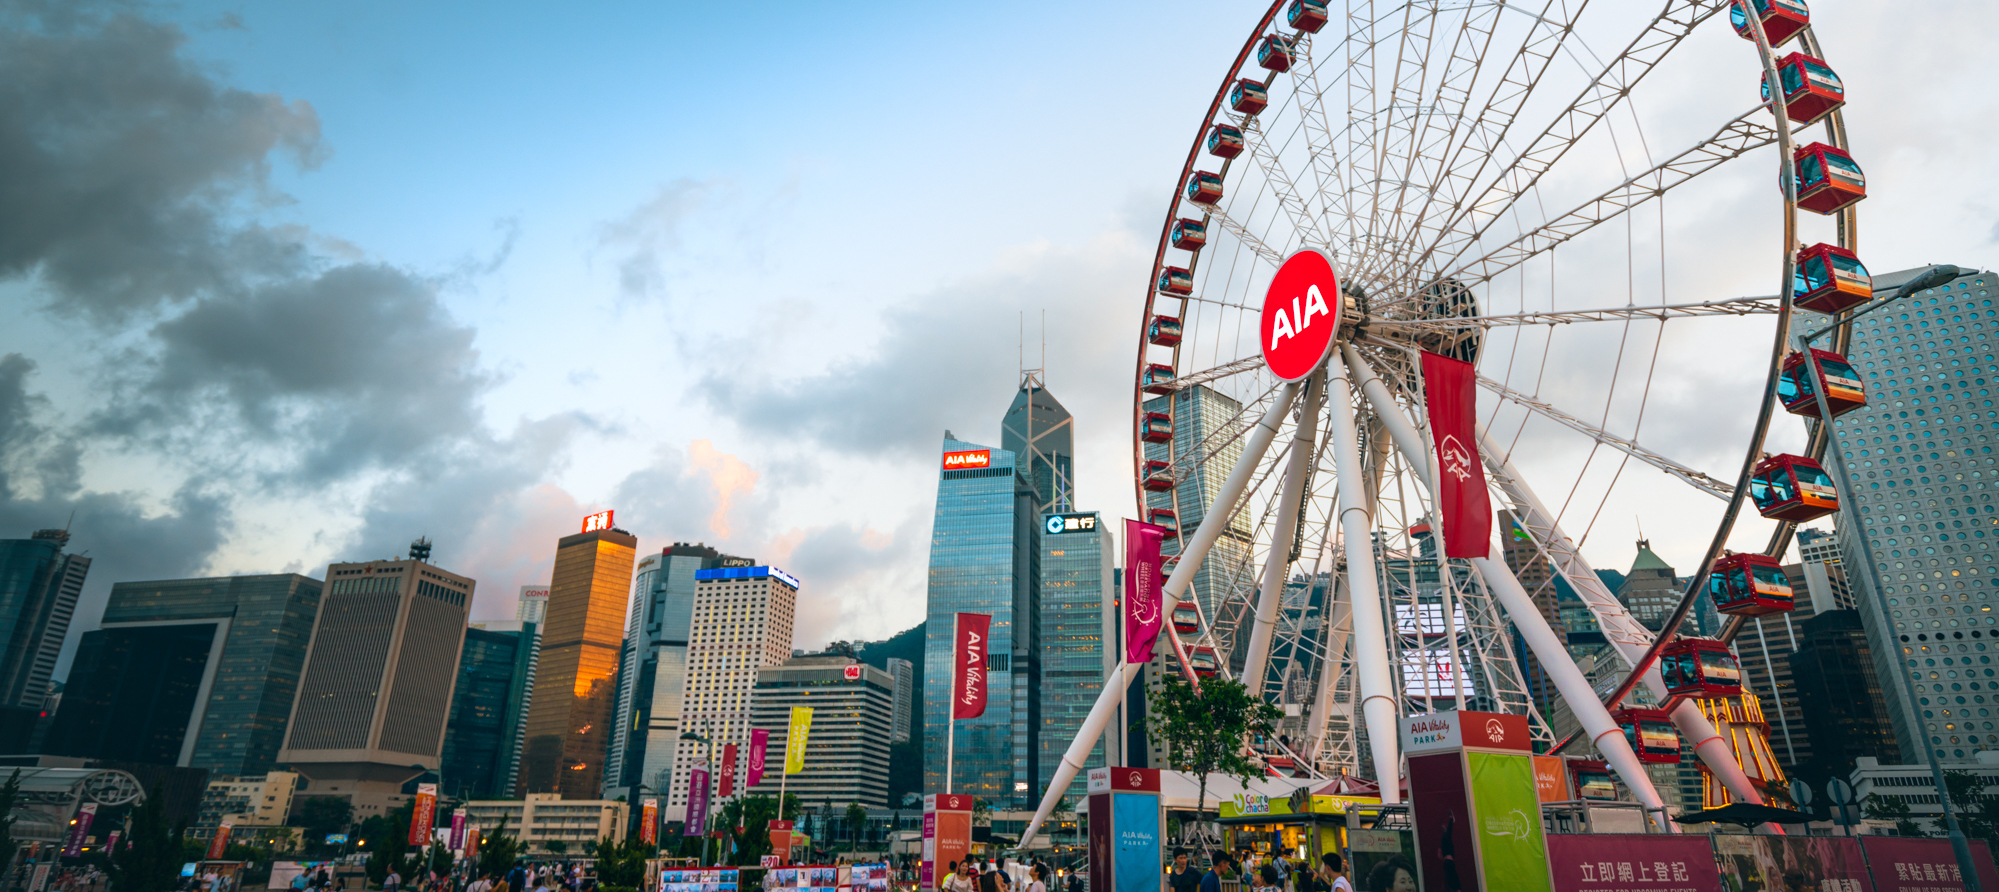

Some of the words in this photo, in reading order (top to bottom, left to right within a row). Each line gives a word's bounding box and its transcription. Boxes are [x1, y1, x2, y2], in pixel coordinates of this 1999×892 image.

[1271, 284, 1330, 352] AIA
[945, 455, 965, 465] AIA
[966, 453, 988, 465] Vitality
[723, 559, 751, 567] LIPPO
[525, 590, 549, 598] CONR
[967, 631, 981, 665] AIA
[961, 667, 982, 706] Vitality
[1411, 721, 1429, 734] AIA
[1428, 719, 1450, 734] Vitality
[800, 724, 808, 742] AIA
[1488, 734, 1505, 743] AIA
[1414, 734, 1437, 745] PARK
[1245, 794, 1264, 804] Color
[1245, 804, 1270, 813] chacha
[1122, 831, 1136, 839] AIA
[1580, 861, 1690, 882] 立即網上登記
